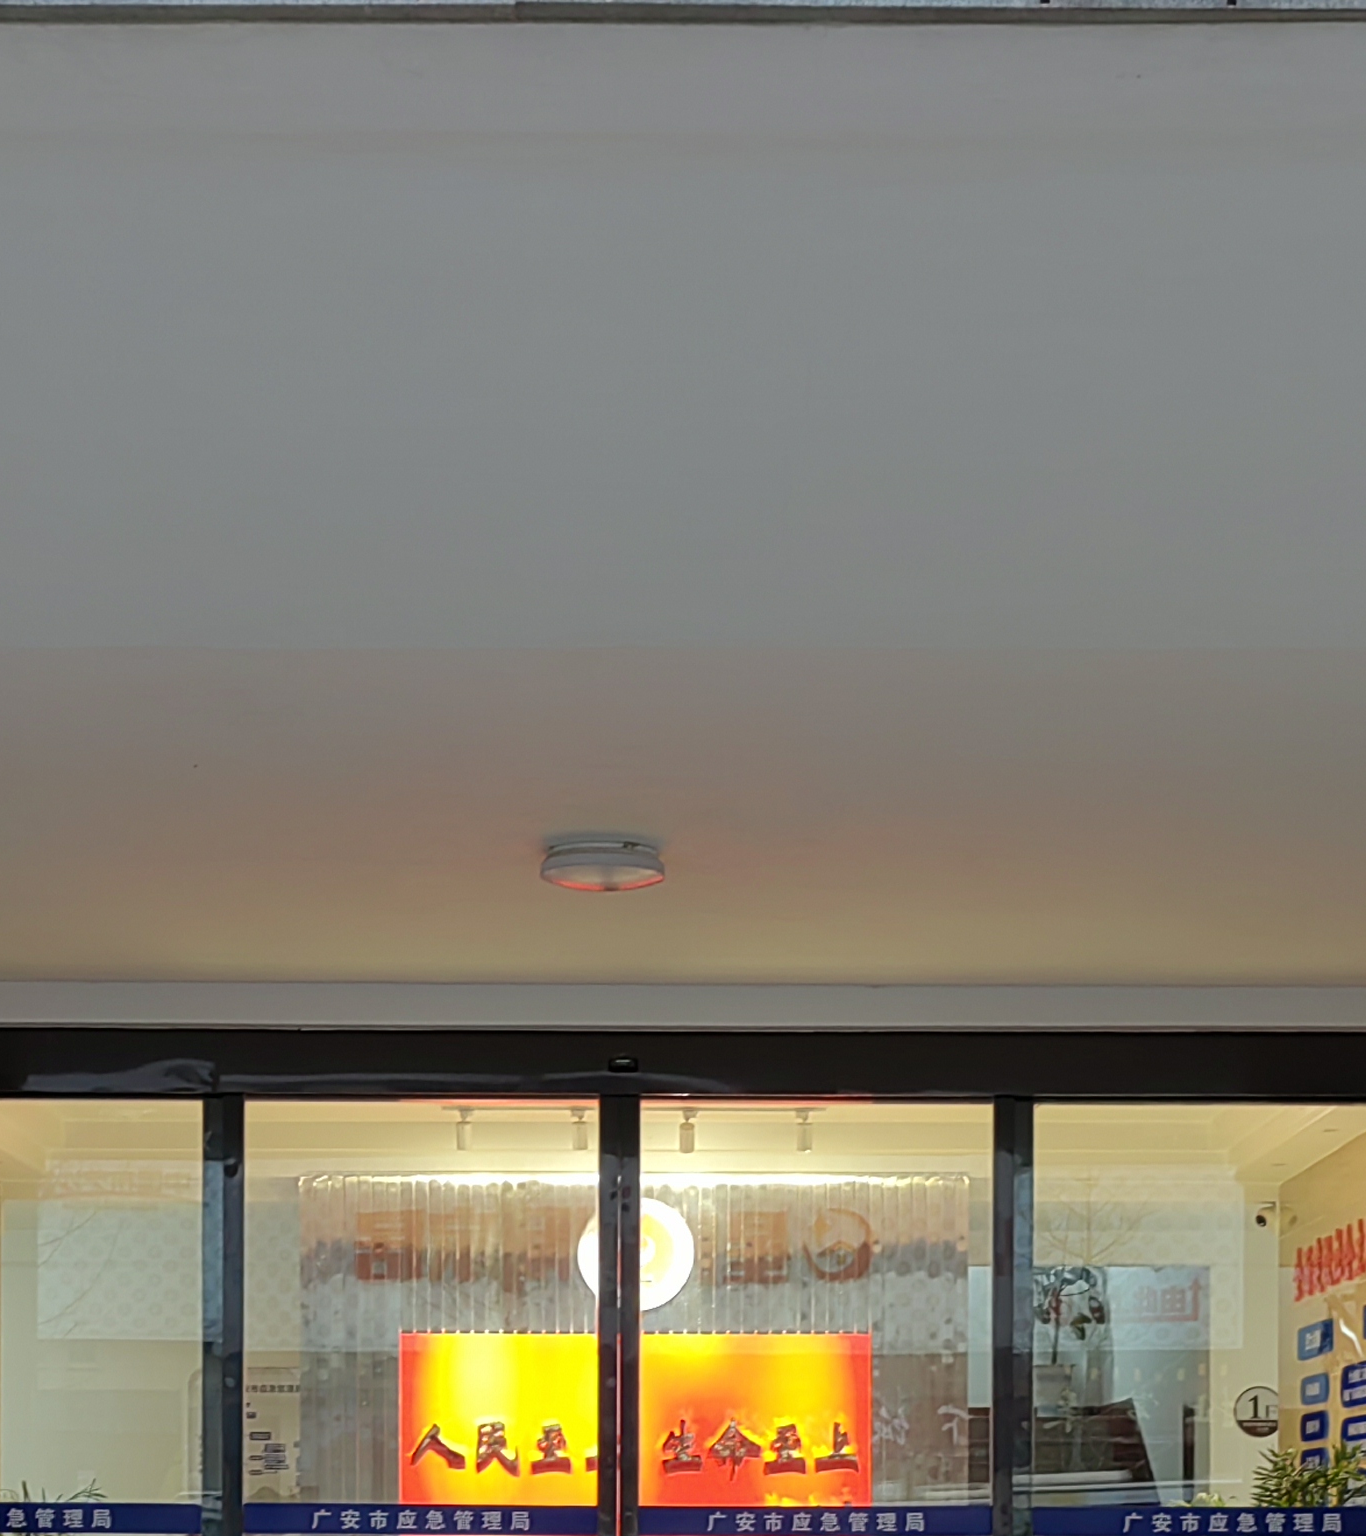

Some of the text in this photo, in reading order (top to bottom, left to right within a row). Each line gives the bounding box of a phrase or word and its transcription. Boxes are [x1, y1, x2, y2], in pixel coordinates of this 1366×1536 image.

[410, 1421, 597, 1476] 人民至
[662, 1417, 859, 1481] 生命至上
[310, 1507, 531, 1532] 广安市应急管理局
[706, 1509, 926, 1533] 广安市应急管理局
[1122, 1512, 1343, 1534] 广安市应急管理局
